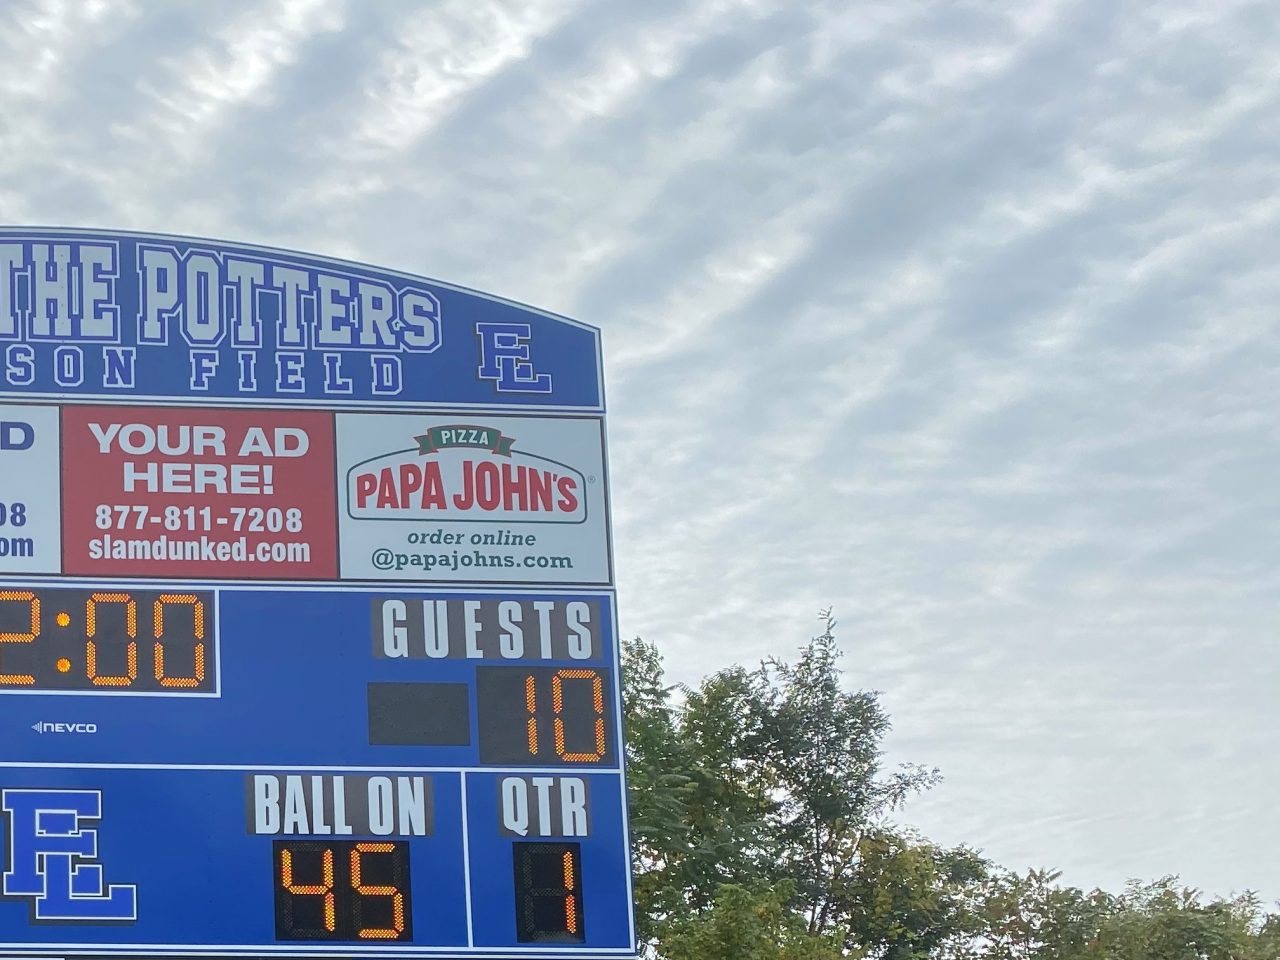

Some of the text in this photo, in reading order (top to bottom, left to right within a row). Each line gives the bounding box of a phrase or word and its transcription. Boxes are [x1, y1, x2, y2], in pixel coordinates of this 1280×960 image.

[136, 242, 443, 354] POTTERS
[189, 350, 404, 396] FIELD
[88, 423, 310, 458] YOUR AD
[441, 429, 489, 446] PIZZA
[123, 462, 274, 495] HERE!
[356, 460, 578, 513] PAPA JOHN'S
[95, 504, 303, 533] 877-811-7208
[408, 529, 537, 546] order online
[88, 534, 311, 563] slamdunked.com
[372, 548, 574, 572] @papajohns.com
[382, 599, 594, 660] GUESTS
[43, 722, 97, 733] NEVCO
[525, 669, 607, 763] 10
[254, 774, 426, 836] BALL ON
[501, 776, 589, 837] QTR
[280, 842, 405, 939] 45
[563, 850, 577, 934] 1
